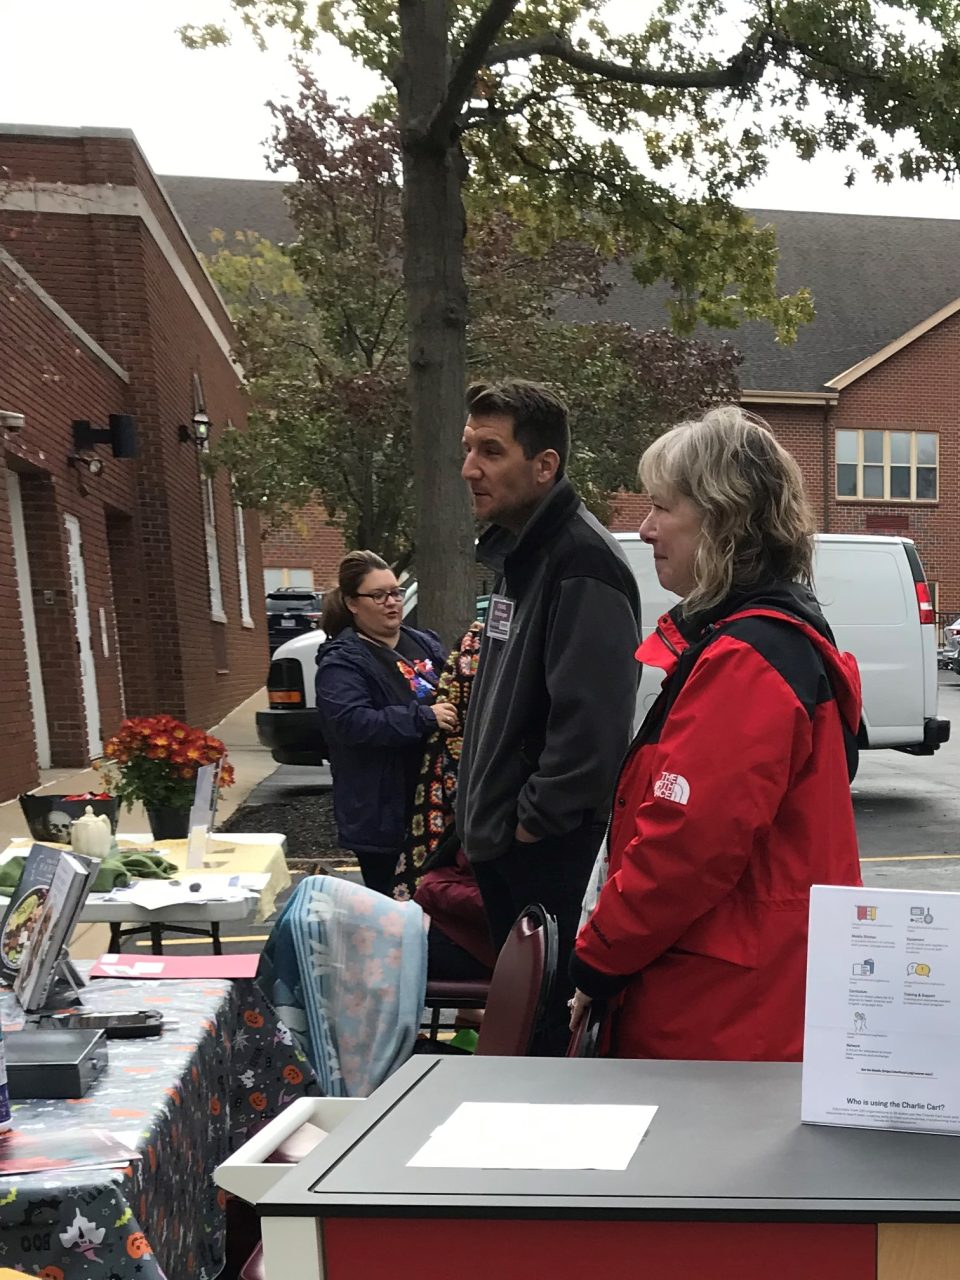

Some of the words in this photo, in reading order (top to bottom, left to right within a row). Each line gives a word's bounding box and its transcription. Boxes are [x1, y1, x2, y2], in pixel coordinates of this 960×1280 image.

[662, 771, 678, 784] THE
[847, 1097, 861, 1105] Who
[870, 1100, 888, 1109] using
[901, 1101, 925, 1110] Charlie
[926, 1103, 945, 1111] Cart?
